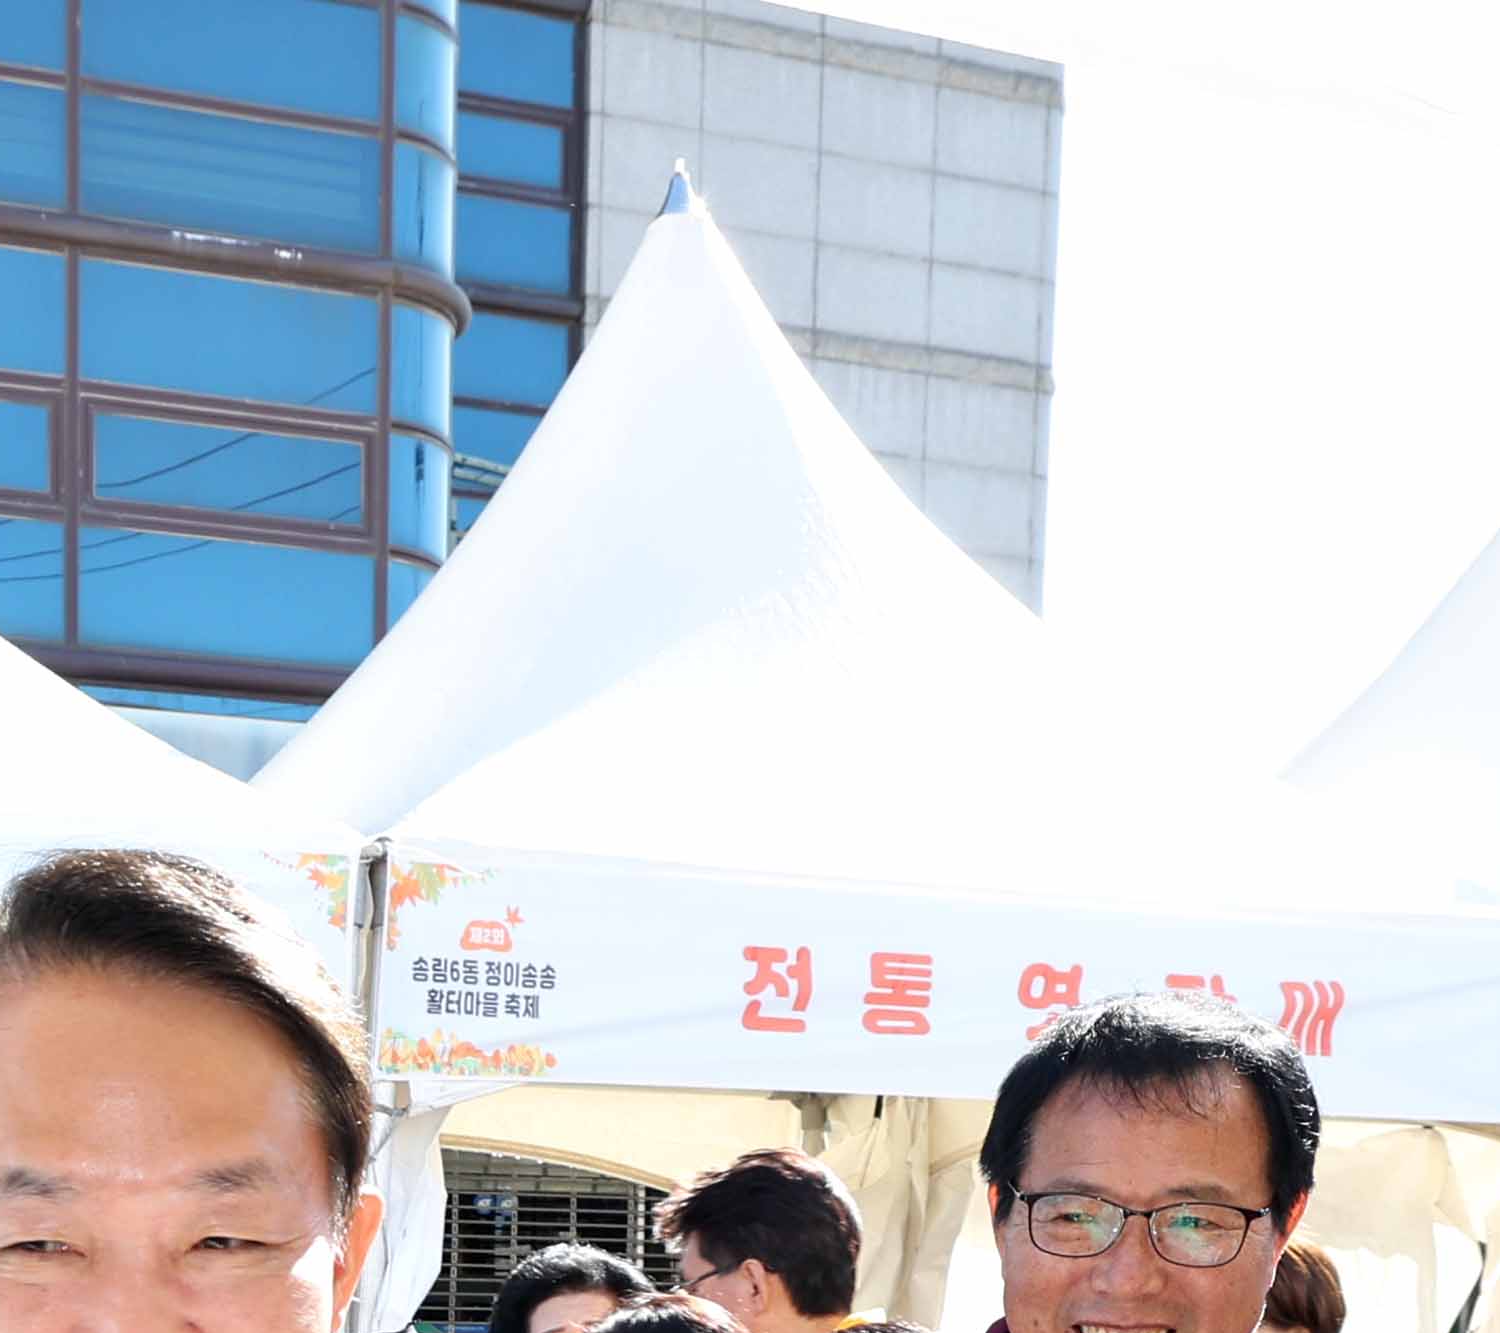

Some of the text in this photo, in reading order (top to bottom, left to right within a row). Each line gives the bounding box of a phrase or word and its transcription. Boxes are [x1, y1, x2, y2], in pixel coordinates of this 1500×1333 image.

[412, 956, 556, 989] 송림6동 정이송송
[426, 989, 540, 1019] 활터마을 축제
